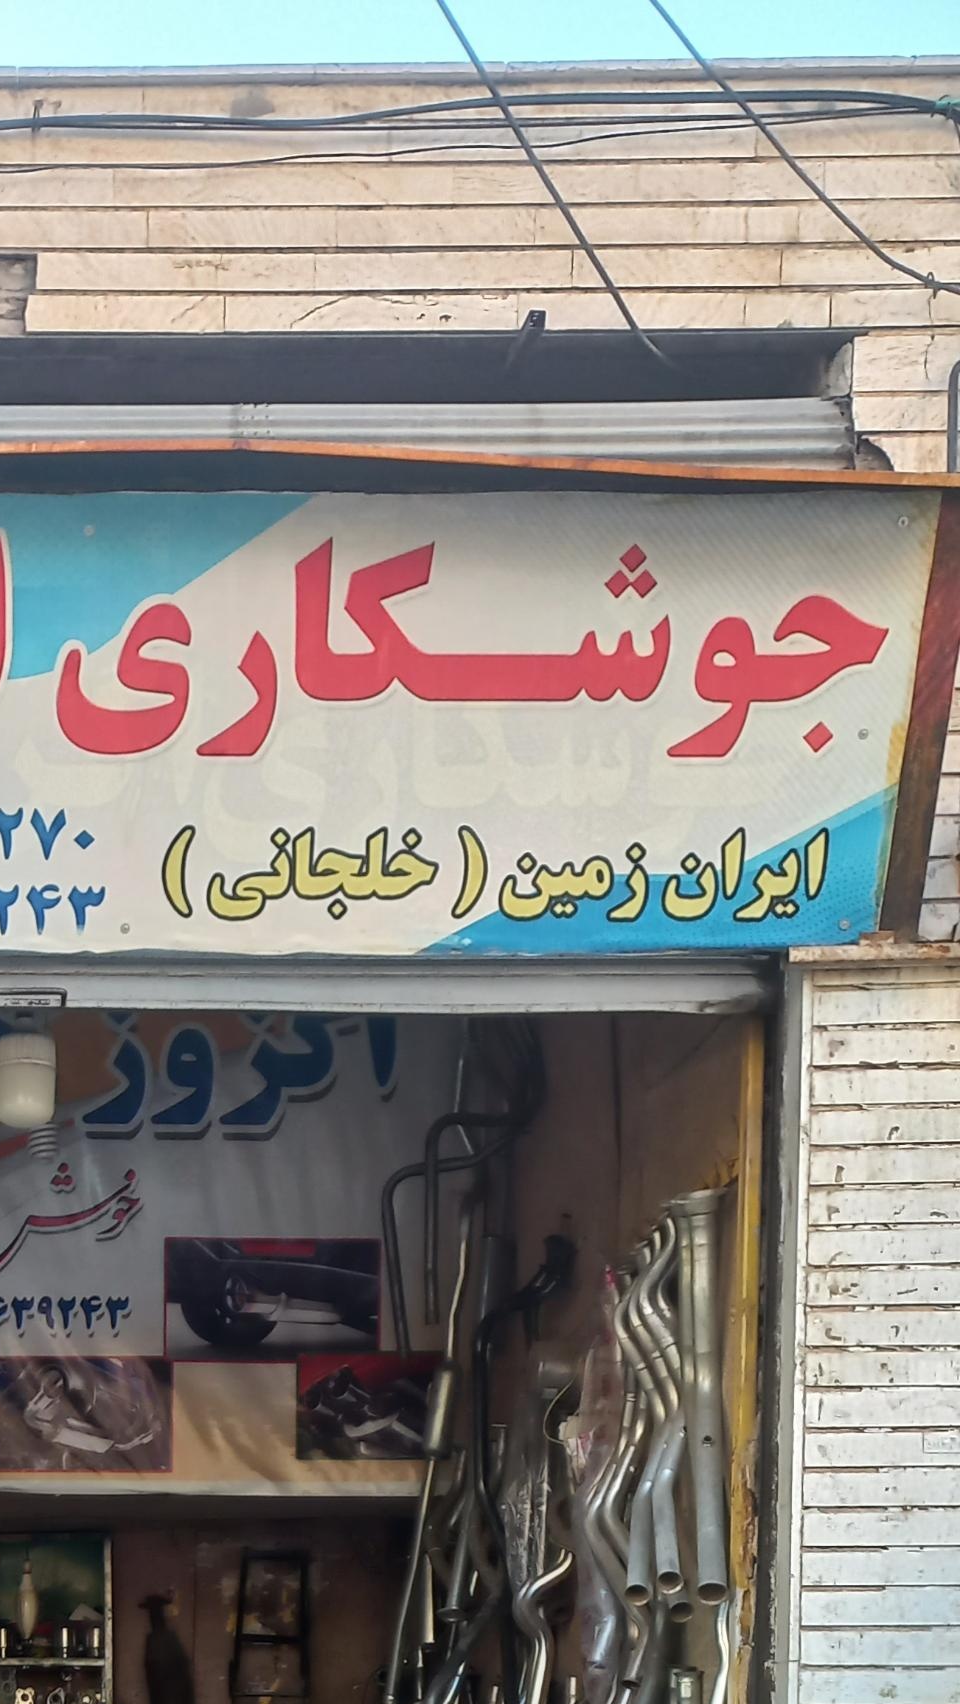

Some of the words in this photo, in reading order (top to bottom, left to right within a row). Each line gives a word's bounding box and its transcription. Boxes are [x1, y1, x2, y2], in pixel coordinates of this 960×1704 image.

[55, 536, 890, 759] جوشکاری
[498, 841, 650, 923] زمین
[661, 826, 830, 923] ایران
